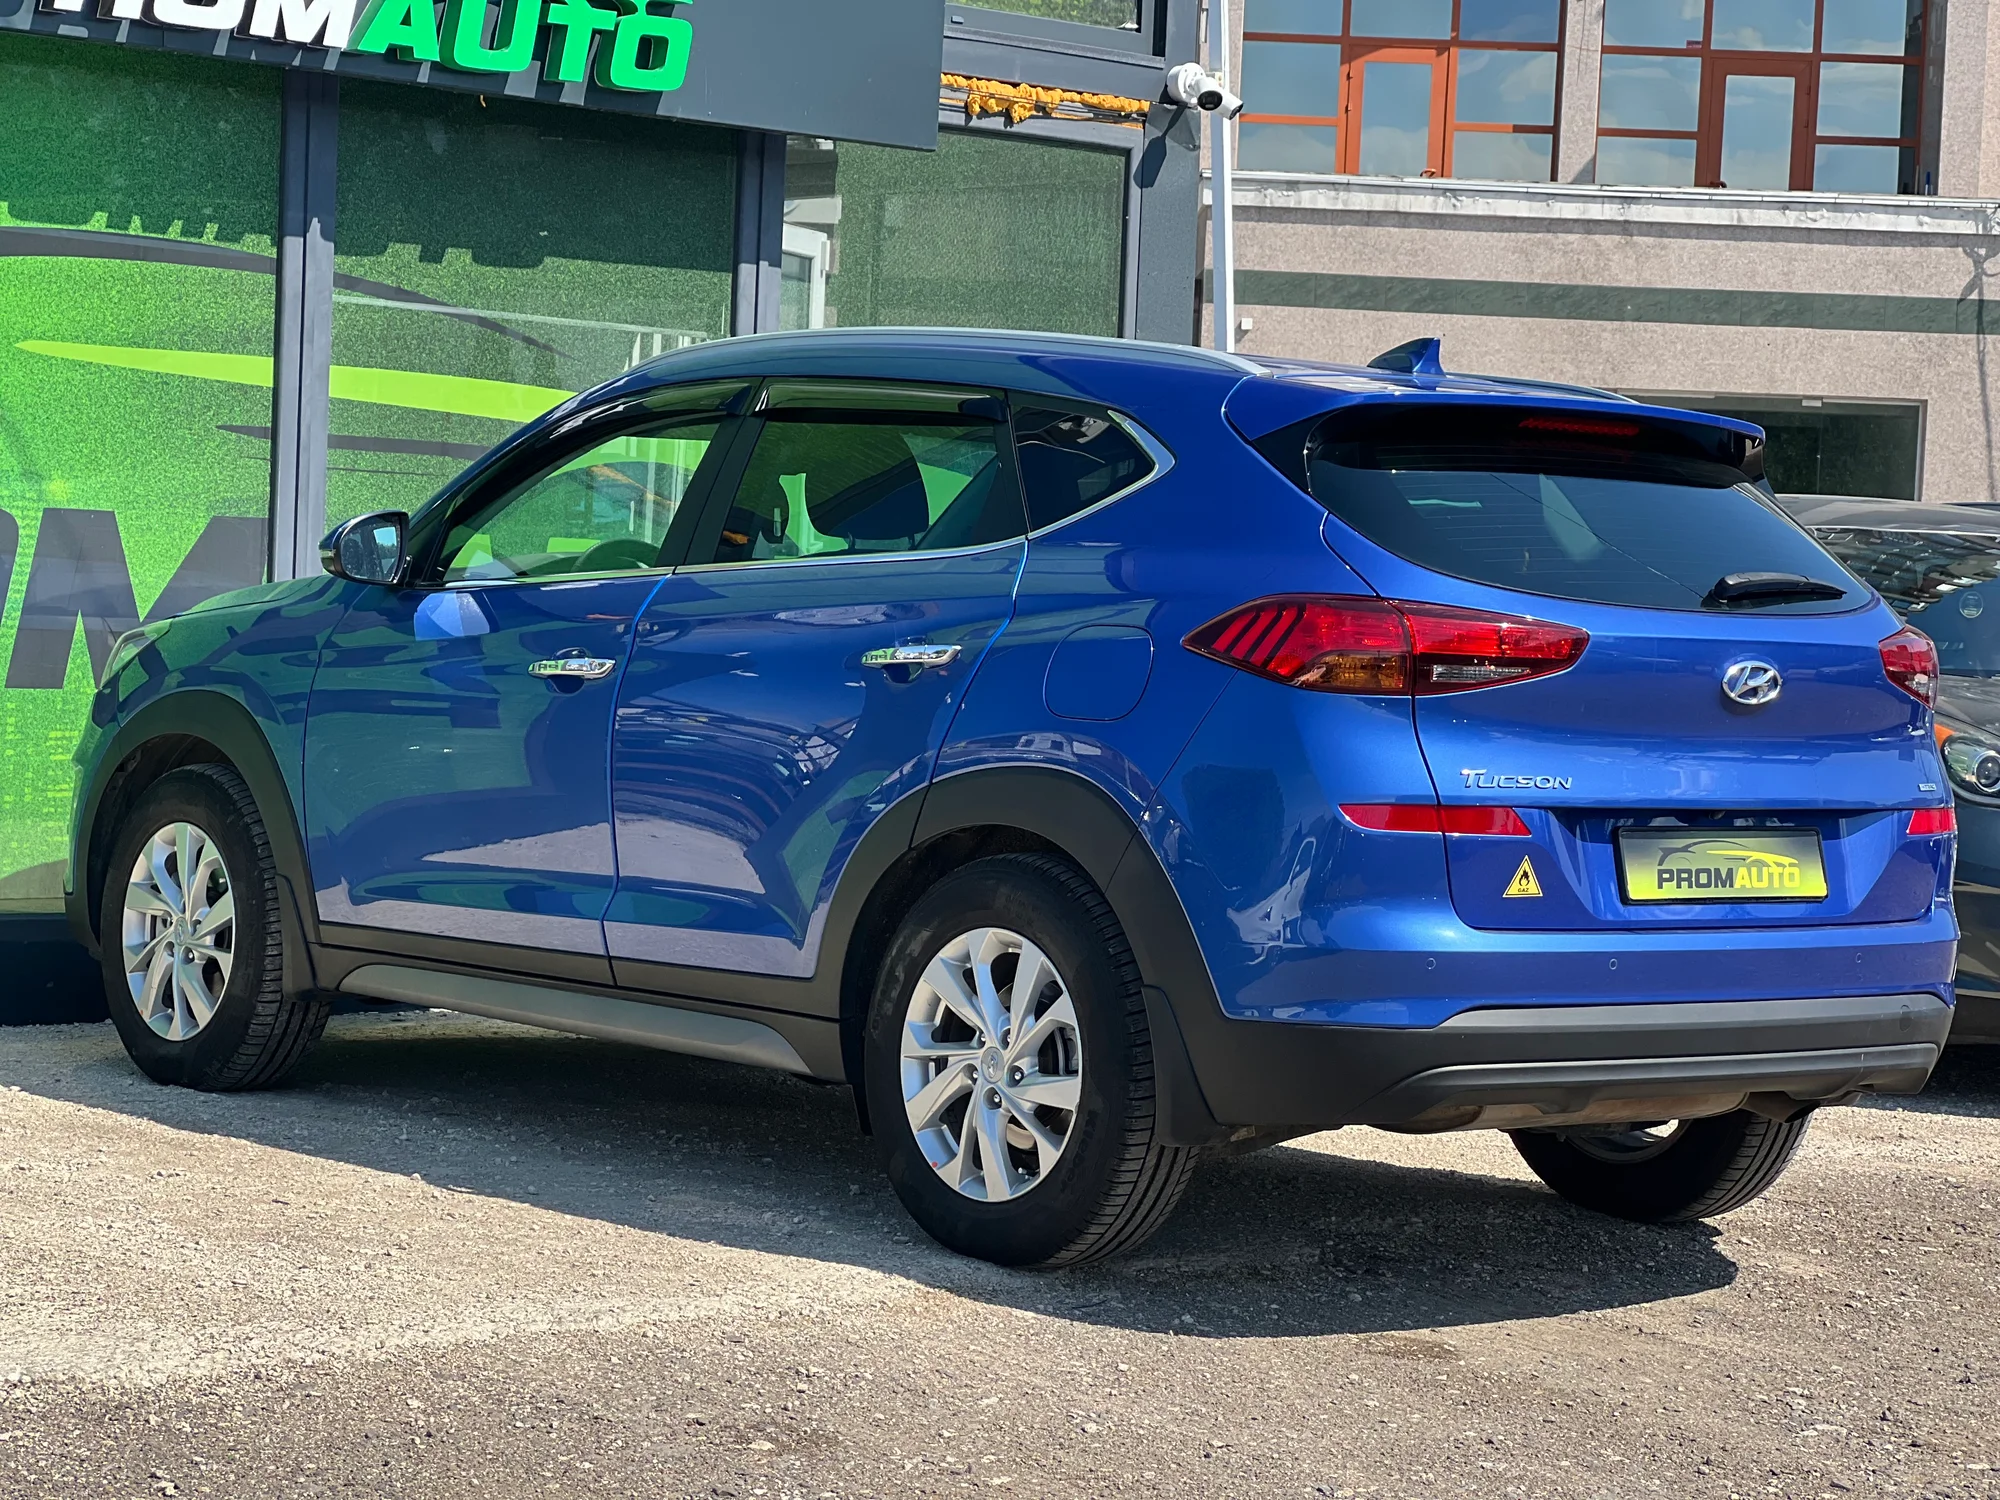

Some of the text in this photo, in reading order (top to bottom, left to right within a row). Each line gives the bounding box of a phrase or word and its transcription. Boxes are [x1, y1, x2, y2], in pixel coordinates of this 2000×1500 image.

[53, 0, 693, 91] MAUTO
[1460, 769, 1573, 790] TUCSON
[1657, 866, 1801, 889] PROMAUTO
